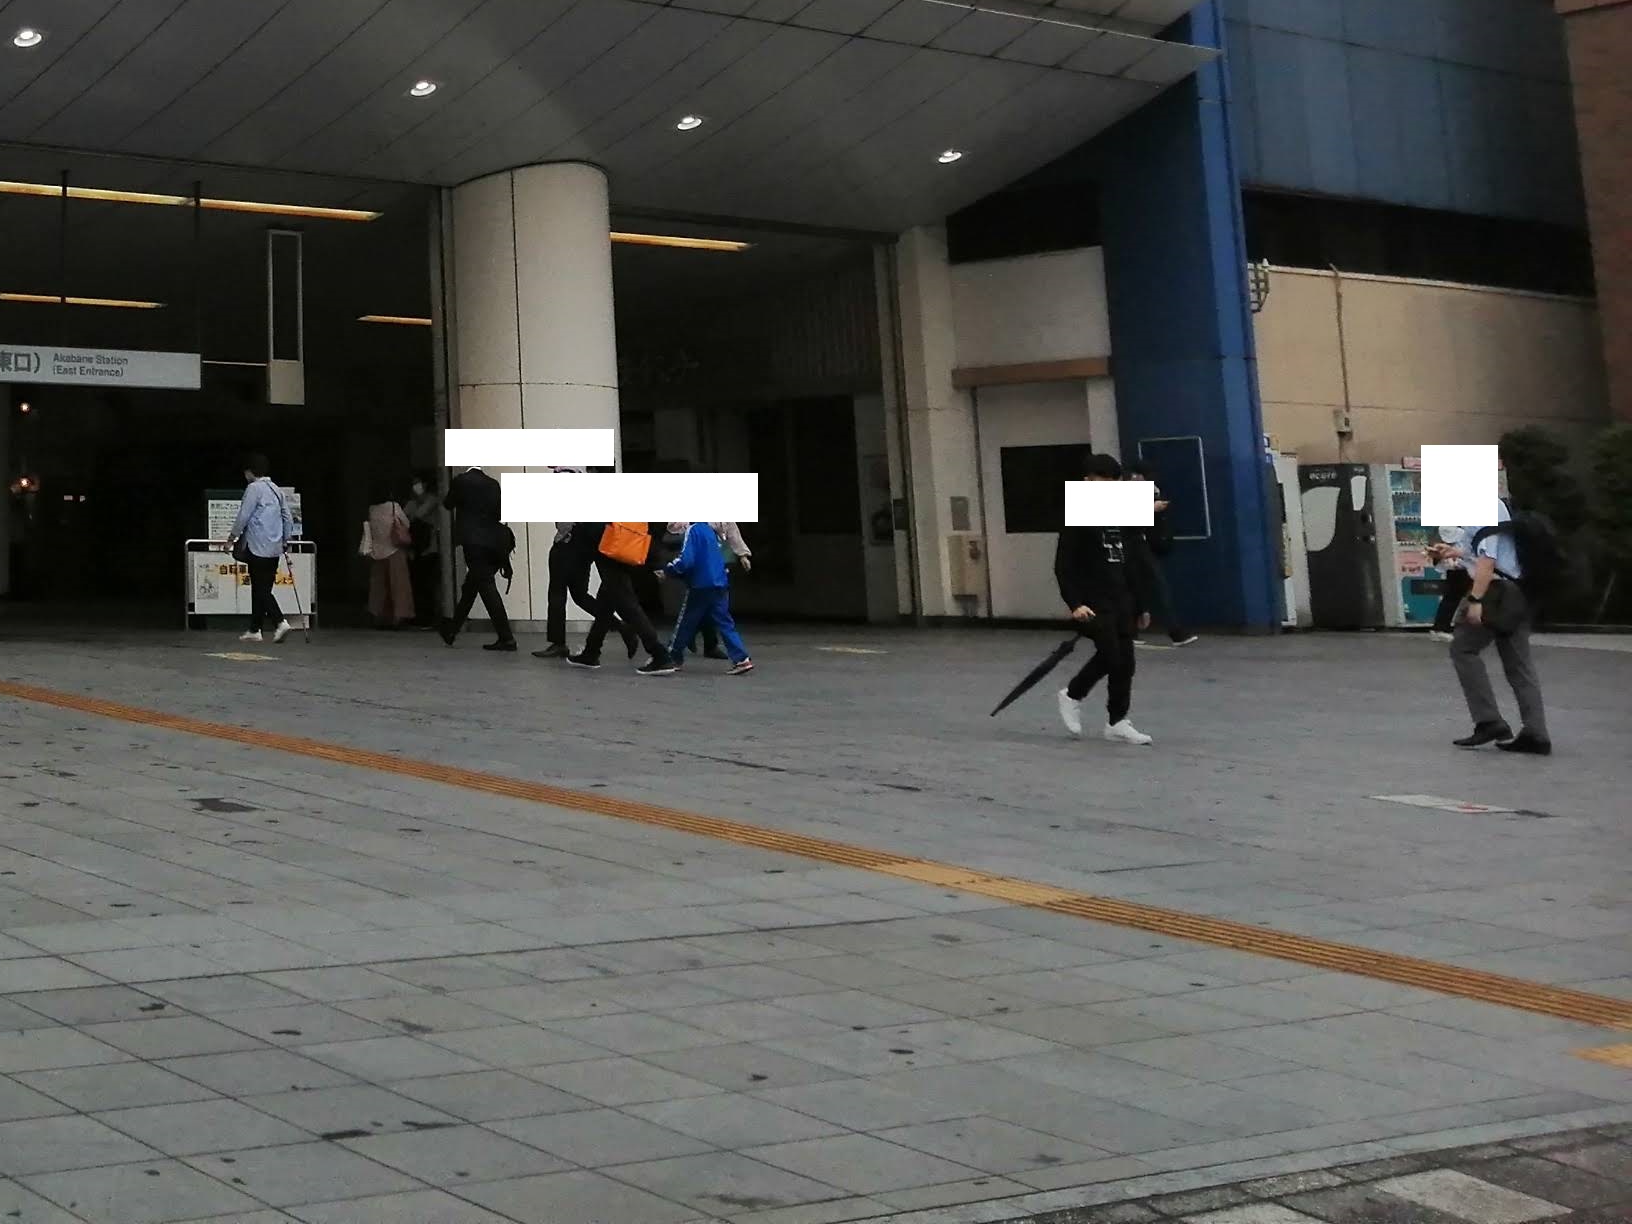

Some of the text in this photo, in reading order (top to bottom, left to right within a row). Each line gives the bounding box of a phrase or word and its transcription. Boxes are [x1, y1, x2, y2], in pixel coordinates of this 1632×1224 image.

[52, 352, 129, 366] Akabane Station
[52, 366, 124, 378] (East Entrance)
